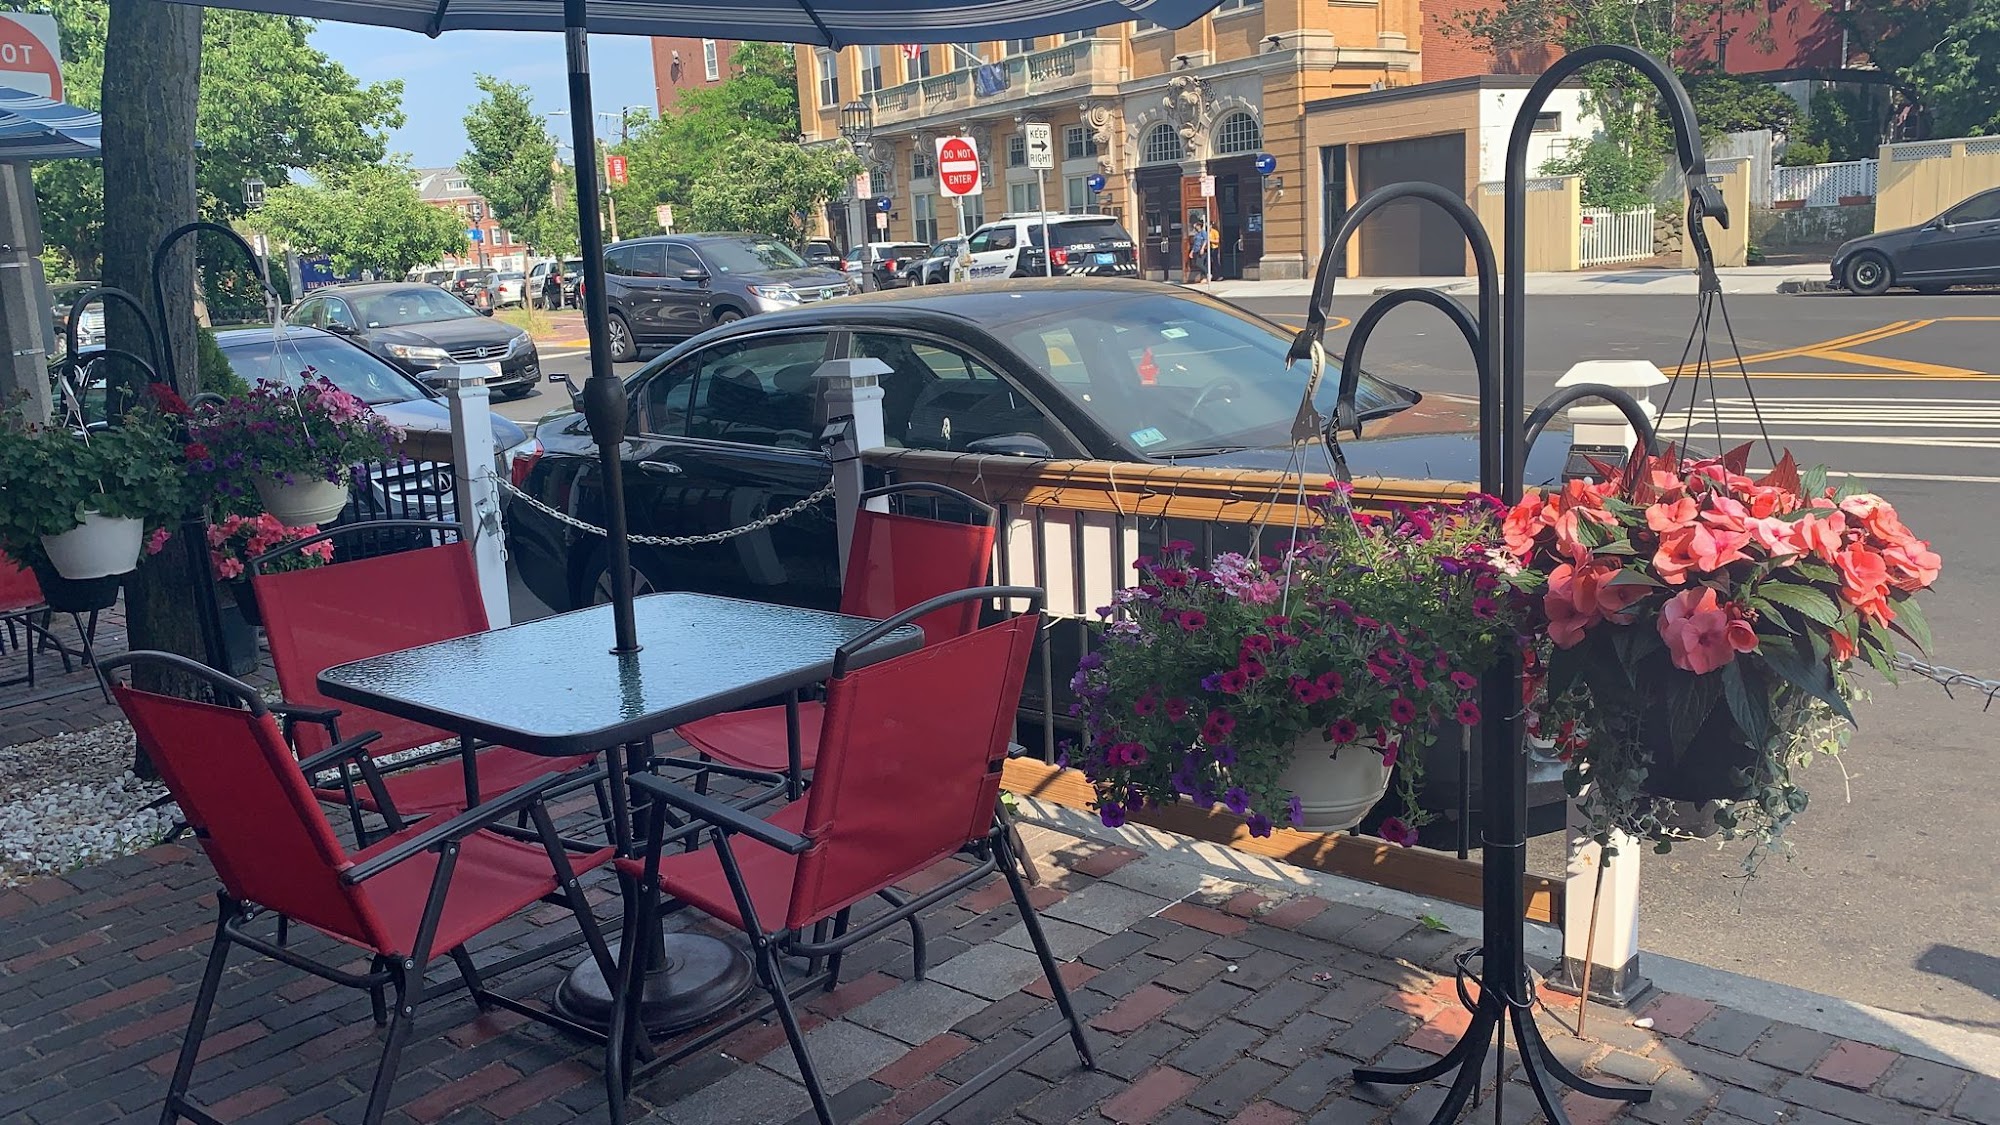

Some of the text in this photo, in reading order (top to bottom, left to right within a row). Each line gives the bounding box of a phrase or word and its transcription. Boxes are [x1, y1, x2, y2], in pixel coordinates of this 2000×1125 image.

[0, 43, 33, 65] OT
[1029, 130, 1048, 139] KEEP
[943, 148, 972, 159] DO NOT
[1030, 153, 1052, 163] RIGHT
[949, 174, 972, 185] ENTER
[1112, 241, 1132, 249] POLICE
